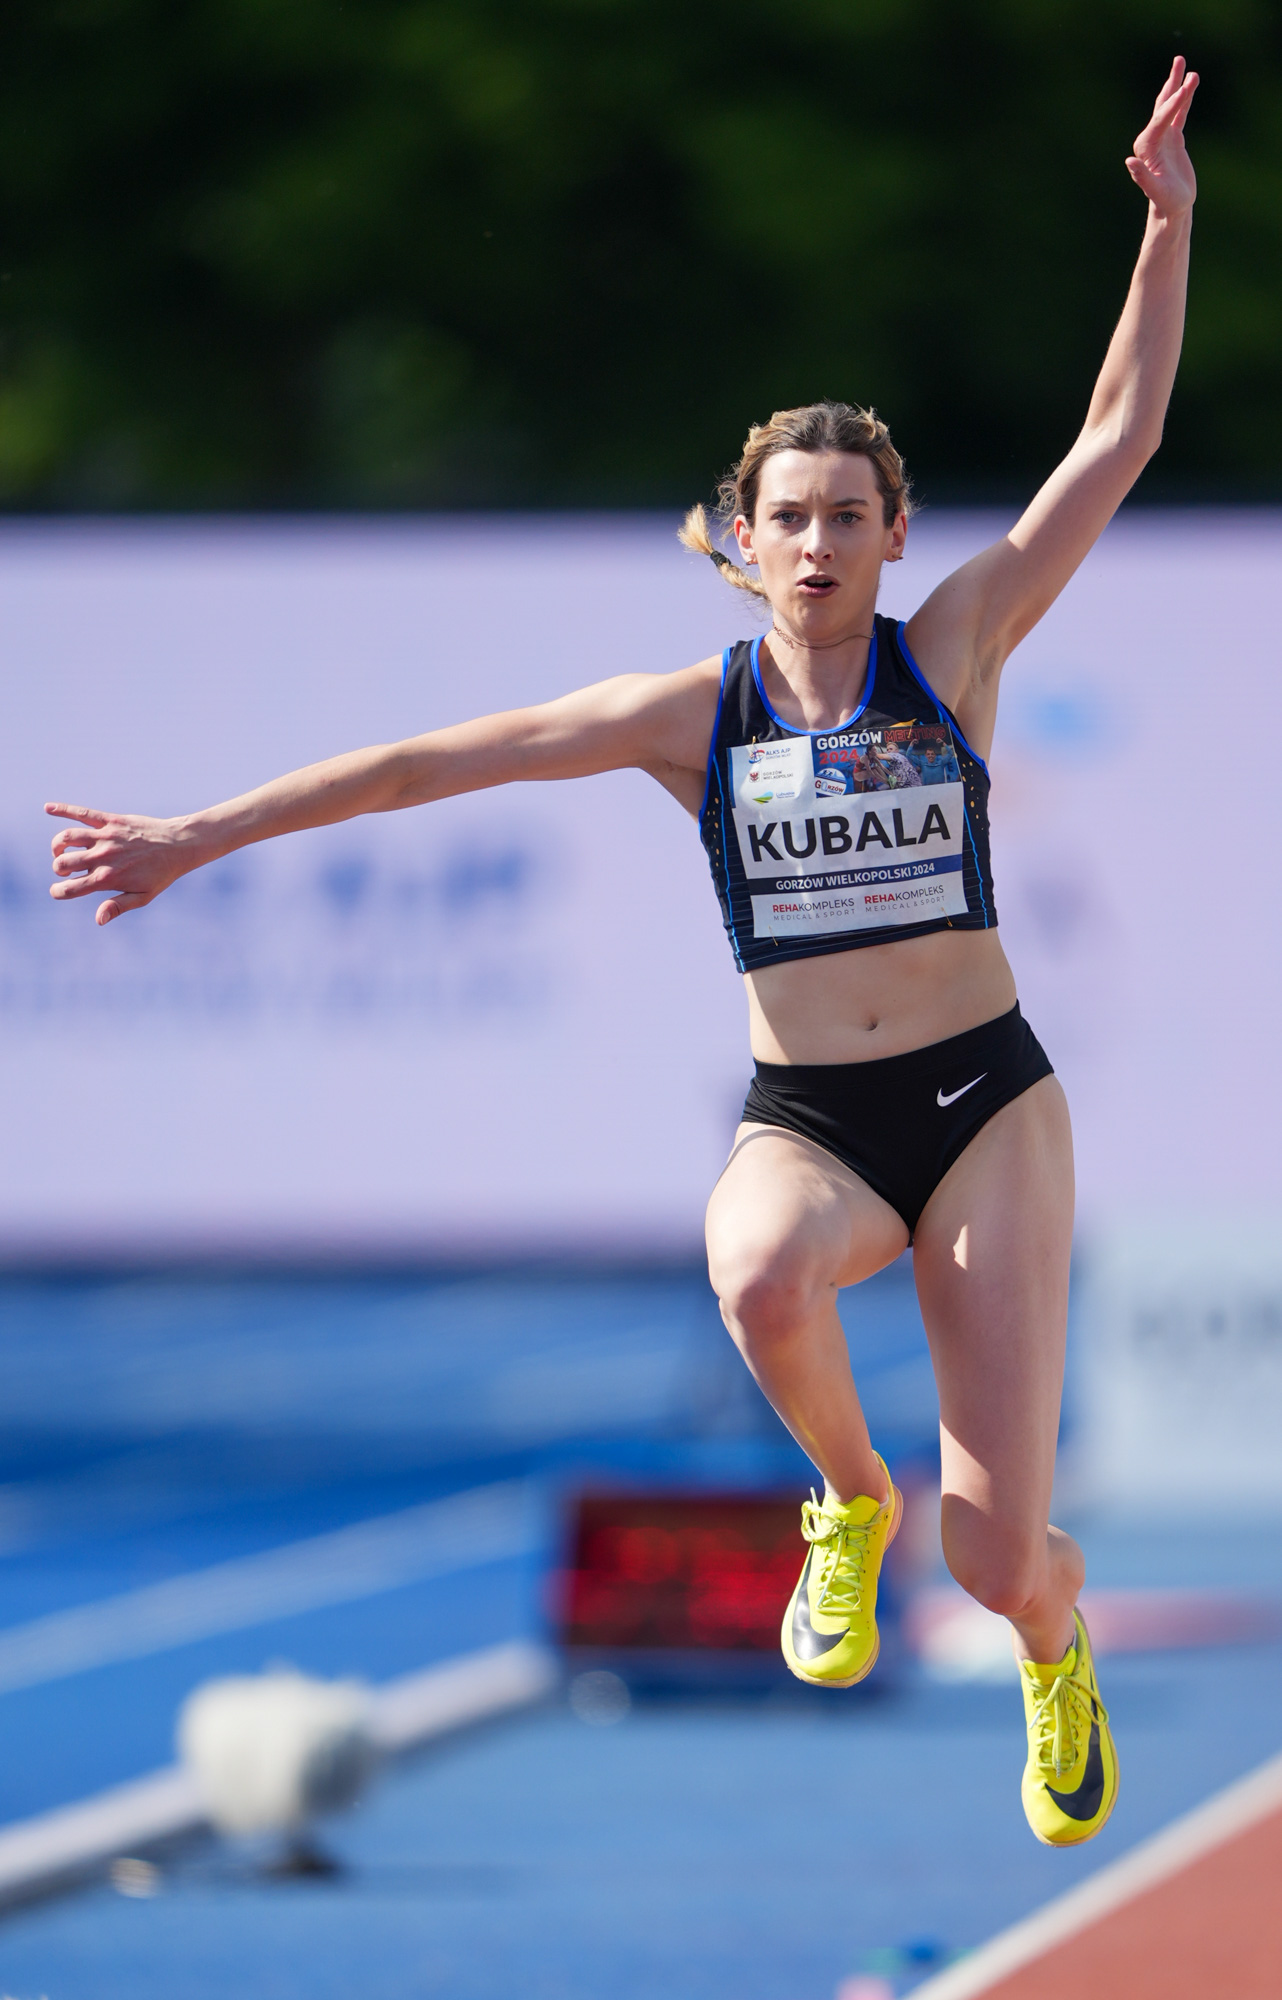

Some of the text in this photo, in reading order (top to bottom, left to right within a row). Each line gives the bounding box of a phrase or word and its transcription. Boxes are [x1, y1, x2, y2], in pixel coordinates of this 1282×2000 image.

[816, 726, 947, 751] GORZÓW MEETING
[819, 748, 860, 765] 2024
[747, 803, 951, 862] KUBALA
[775, 862, 935, 891] GORZÓW WIELKOPOLSKI 2024
[864, 885, 944, 905] REHAKOMPLEKS
[865, 902, 911, 912] MEDICAL
[920, 895, 945, 906] SPORT
[772, 898, 855, 913] REHAKOMPLEKS
[773, 913, 813, 921] MEDICAL
[823, 908, 855, 918] SPORT
